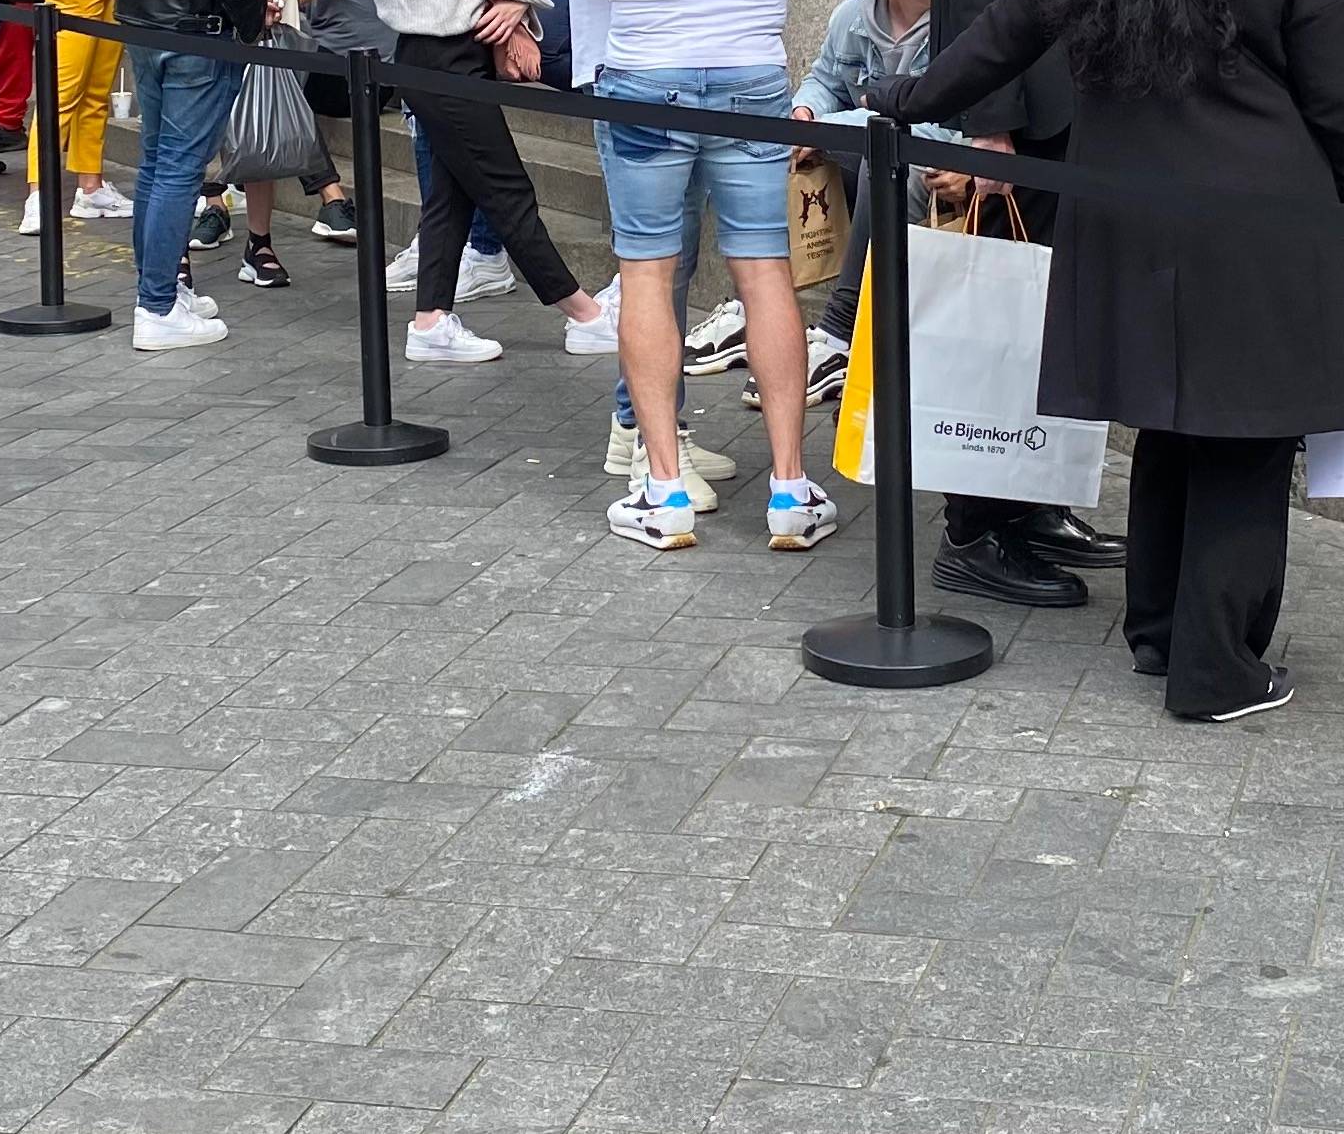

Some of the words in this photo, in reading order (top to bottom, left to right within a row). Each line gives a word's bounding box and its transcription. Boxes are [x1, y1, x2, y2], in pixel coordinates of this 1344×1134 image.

[934, 421, 953, 435] de
[955, 422, 1023, 444] Bijenkorf
[962, 443, 984, 453] sinds
[987, 445, 1006, 455] 1870
